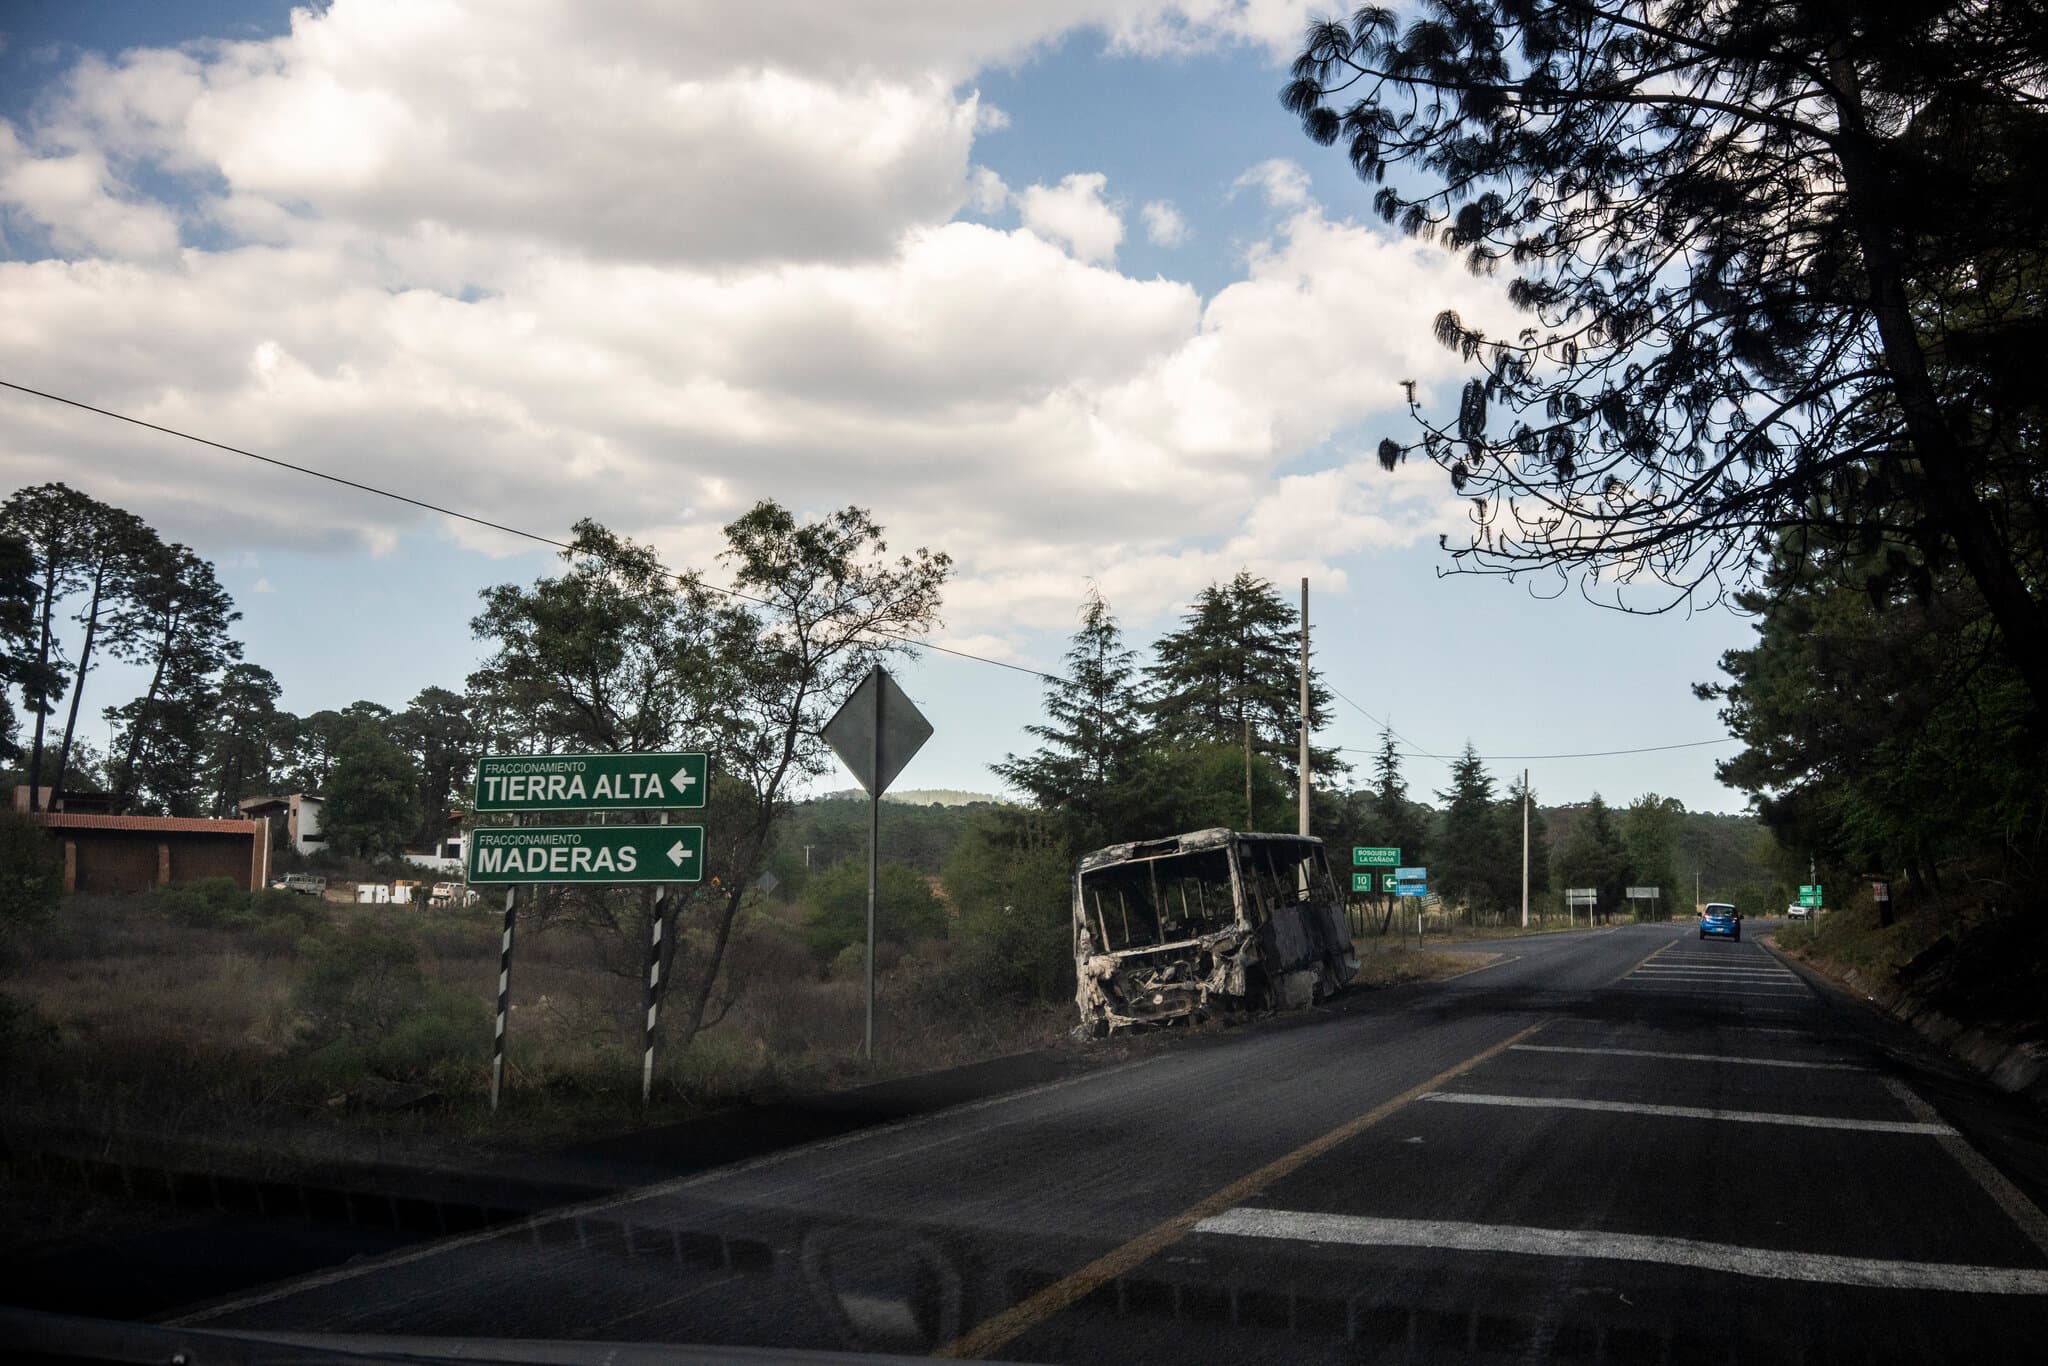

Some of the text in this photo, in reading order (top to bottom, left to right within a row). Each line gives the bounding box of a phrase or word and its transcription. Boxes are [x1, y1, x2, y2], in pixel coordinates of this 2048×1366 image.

[485, 762, 586, 774] FRACCIONAMIENTO
[484, 773, 665, 801] TIERRA ALTA
[479, 834, 582, 845] FRACCIONAMIENTO
[477, 846, 637, 873] MADERAS
[1357, 876, 1367, 884] 10
